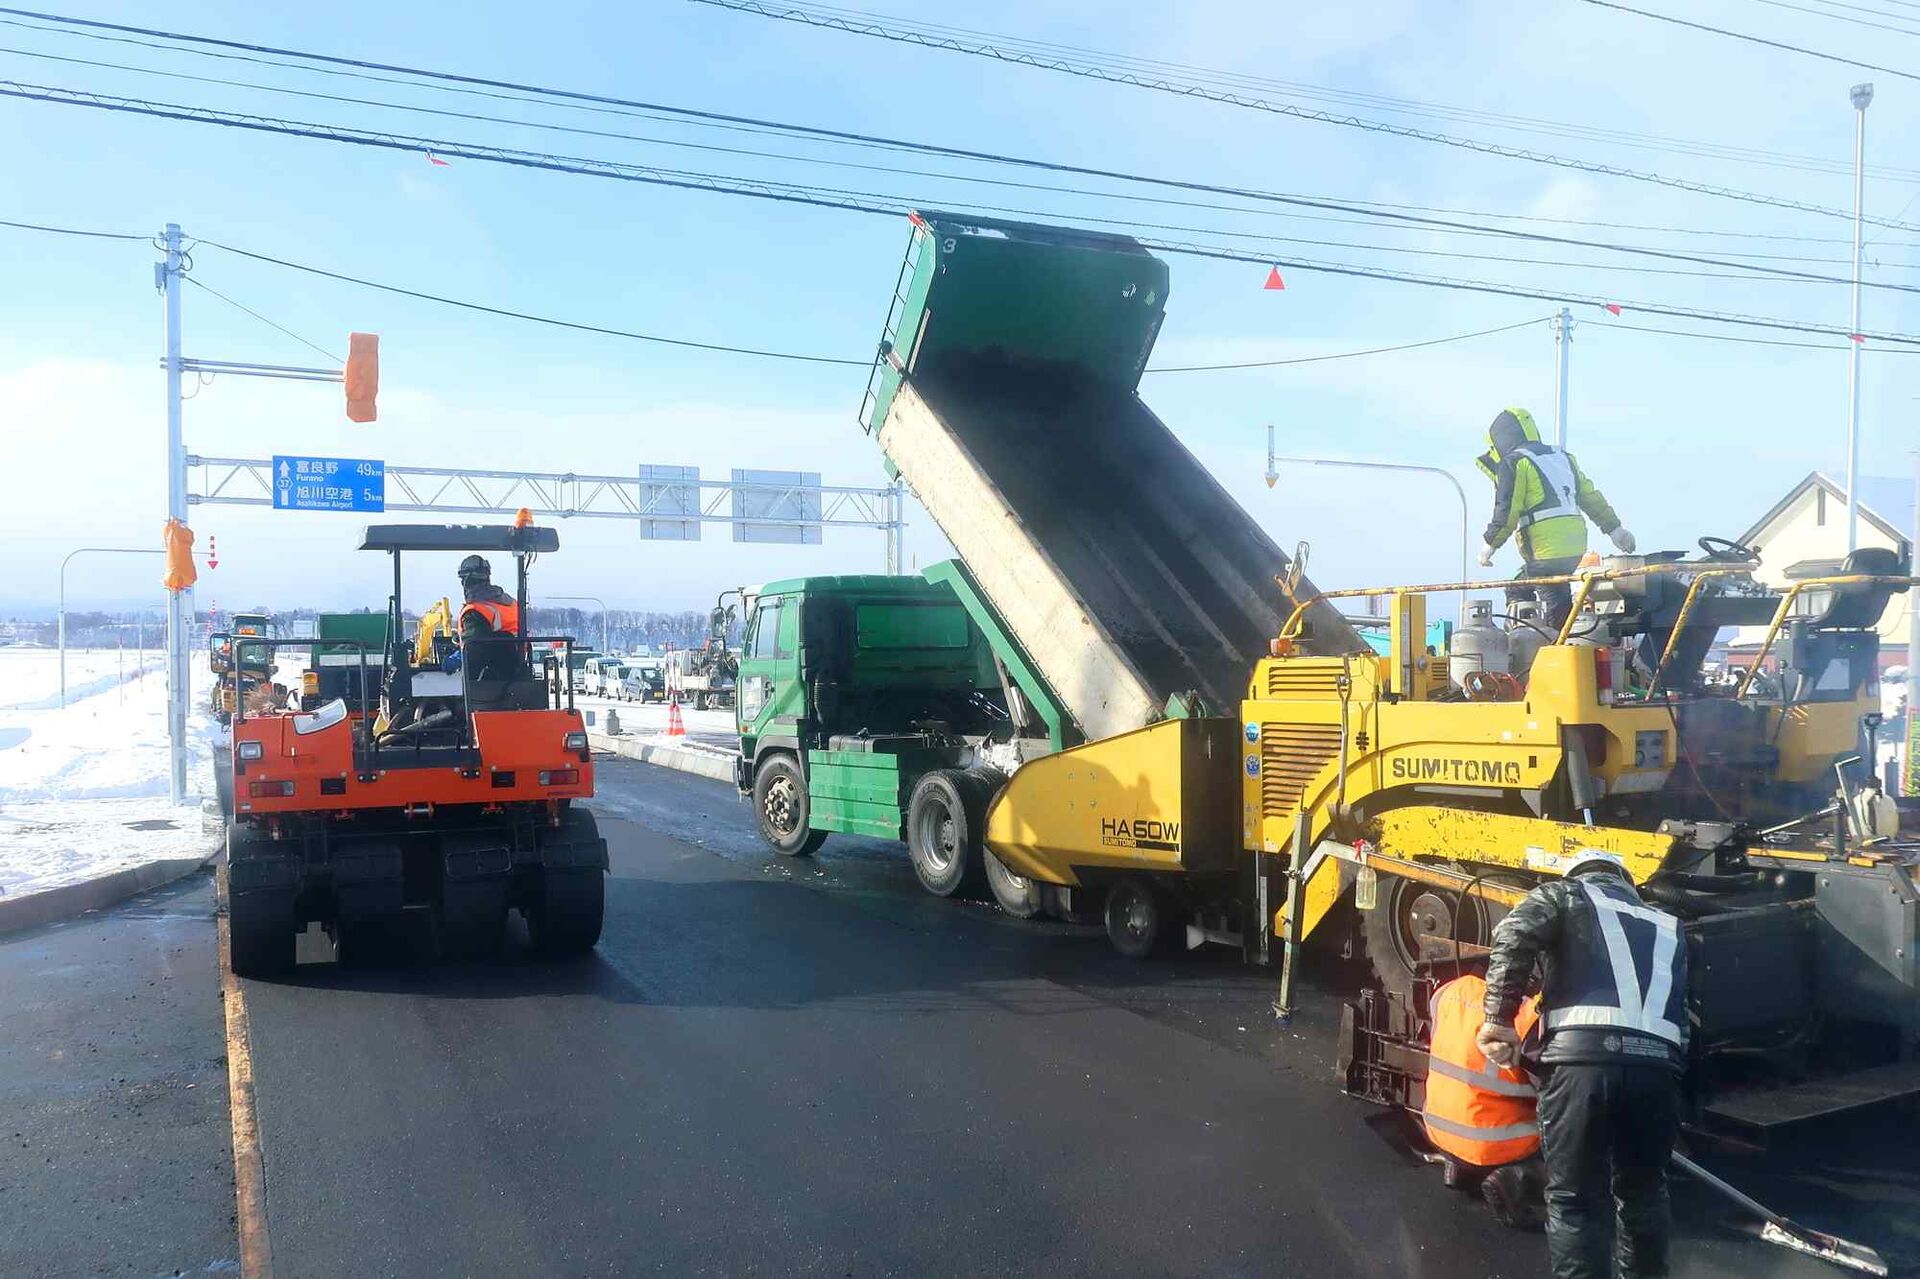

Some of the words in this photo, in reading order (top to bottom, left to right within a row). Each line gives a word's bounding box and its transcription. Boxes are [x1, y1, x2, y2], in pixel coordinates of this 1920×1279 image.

[943, 238, 956, 253] 3
[296, 461, 338, 474] 富良野
[296, 474, 324, 482] Furano
[296, 486, 353, 500] 旭川空港
[1393, 758, 1520, 784] SUMITOMO
[1102, 818, 1179, 840] HA60W
